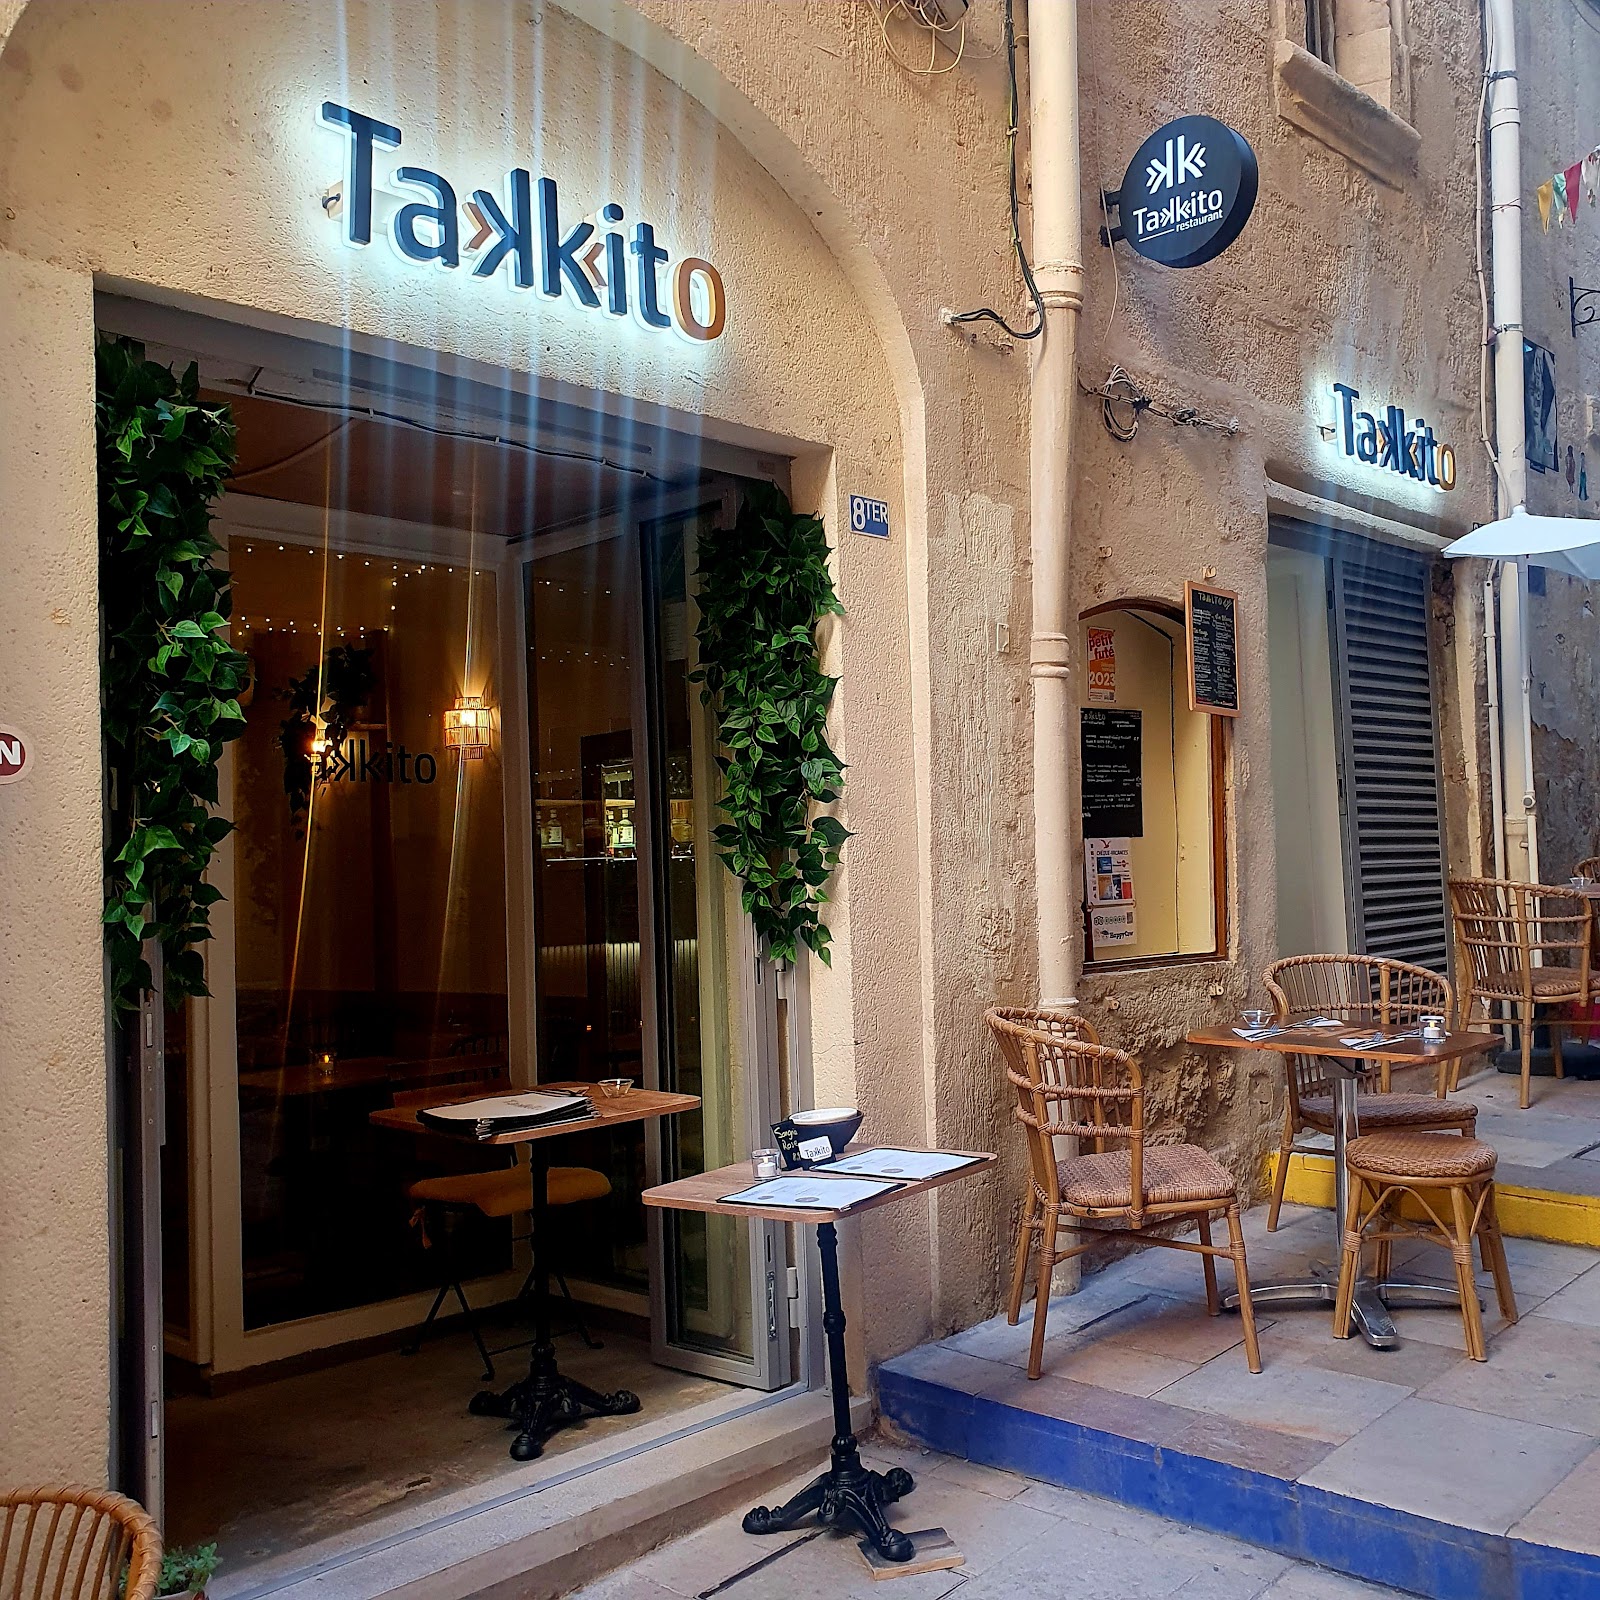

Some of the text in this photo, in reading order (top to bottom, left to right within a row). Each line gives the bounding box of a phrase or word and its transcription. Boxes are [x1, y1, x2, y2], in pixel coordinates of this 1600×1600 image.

[320, 101, 726, 340] Takkito
[1132, 190, 1223, 235] Takkito
[1176, 209, 1223, 232] restaurant
[1333, 383, 1457, 491] Takkito
[1089, 632, 1114, 651] petit
[1094, 645, 1115, 661] futé
[1089, 671, 1115, 686] 2023
